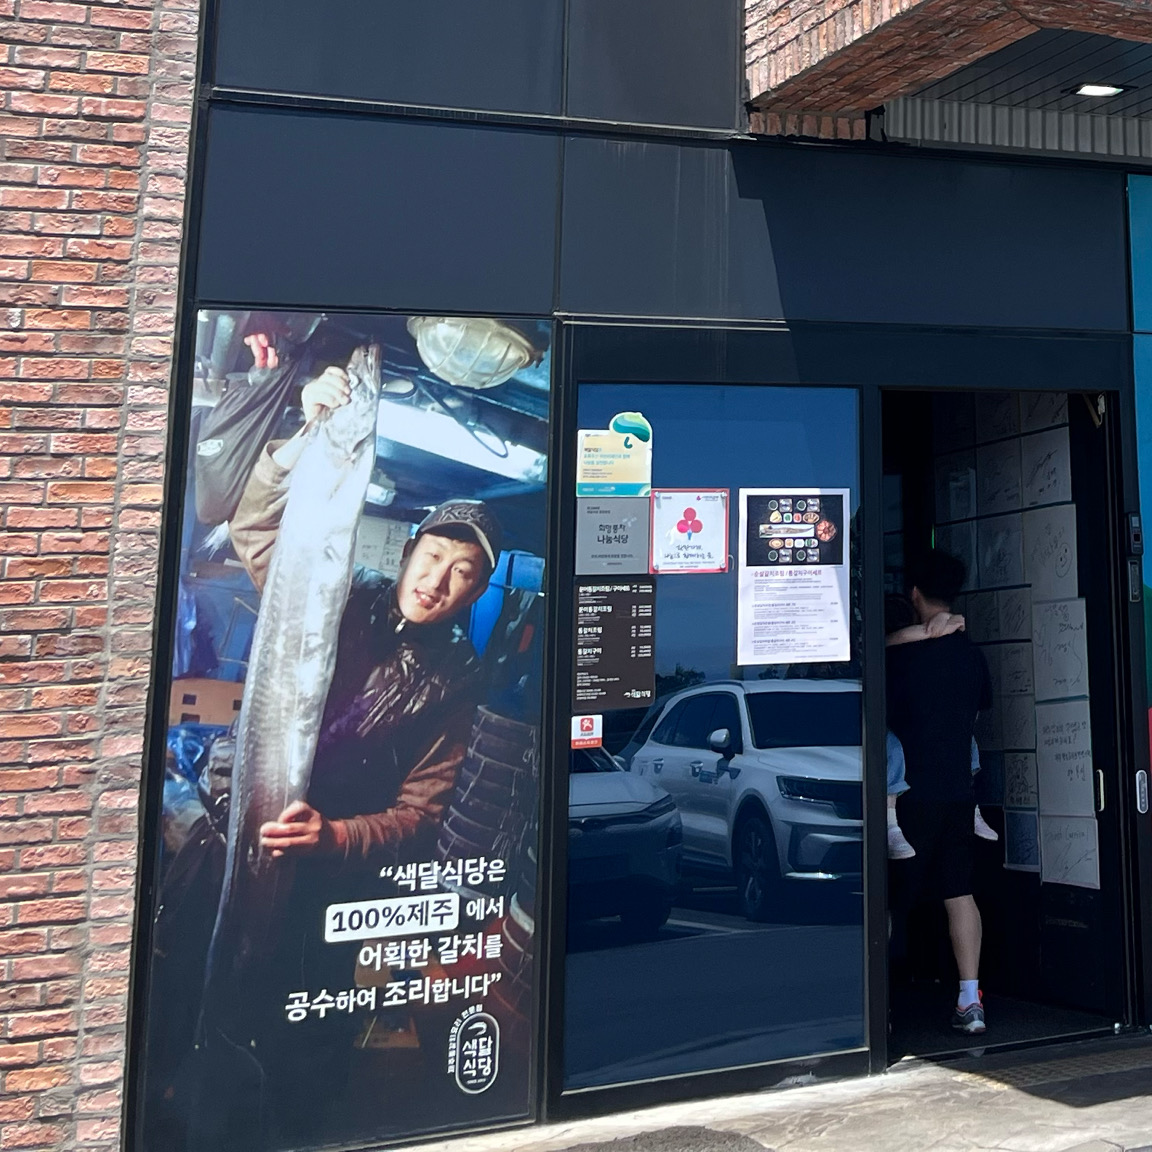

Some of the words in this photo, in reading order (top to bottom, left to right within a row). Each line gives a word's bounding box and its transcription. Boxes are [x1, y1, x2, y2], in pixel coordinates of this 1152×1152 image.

[597, 535, 629, 544] 나눔식당
[379, 856, 507, 892] “색달식당은
[332, 898, 454, 933] 100%제주
[465, 896, 505, 921] 에서
[358, 938, 433, 972] 어획한
[437, 932, 504, 966] 갈치를
[285, 986, 378, 1022] 공수하여
[382, 972, 502, 1008] 조리합니다”
[462, 1035, 493, 1058] 색달
[463, 1056, 492, 1077] 식당
